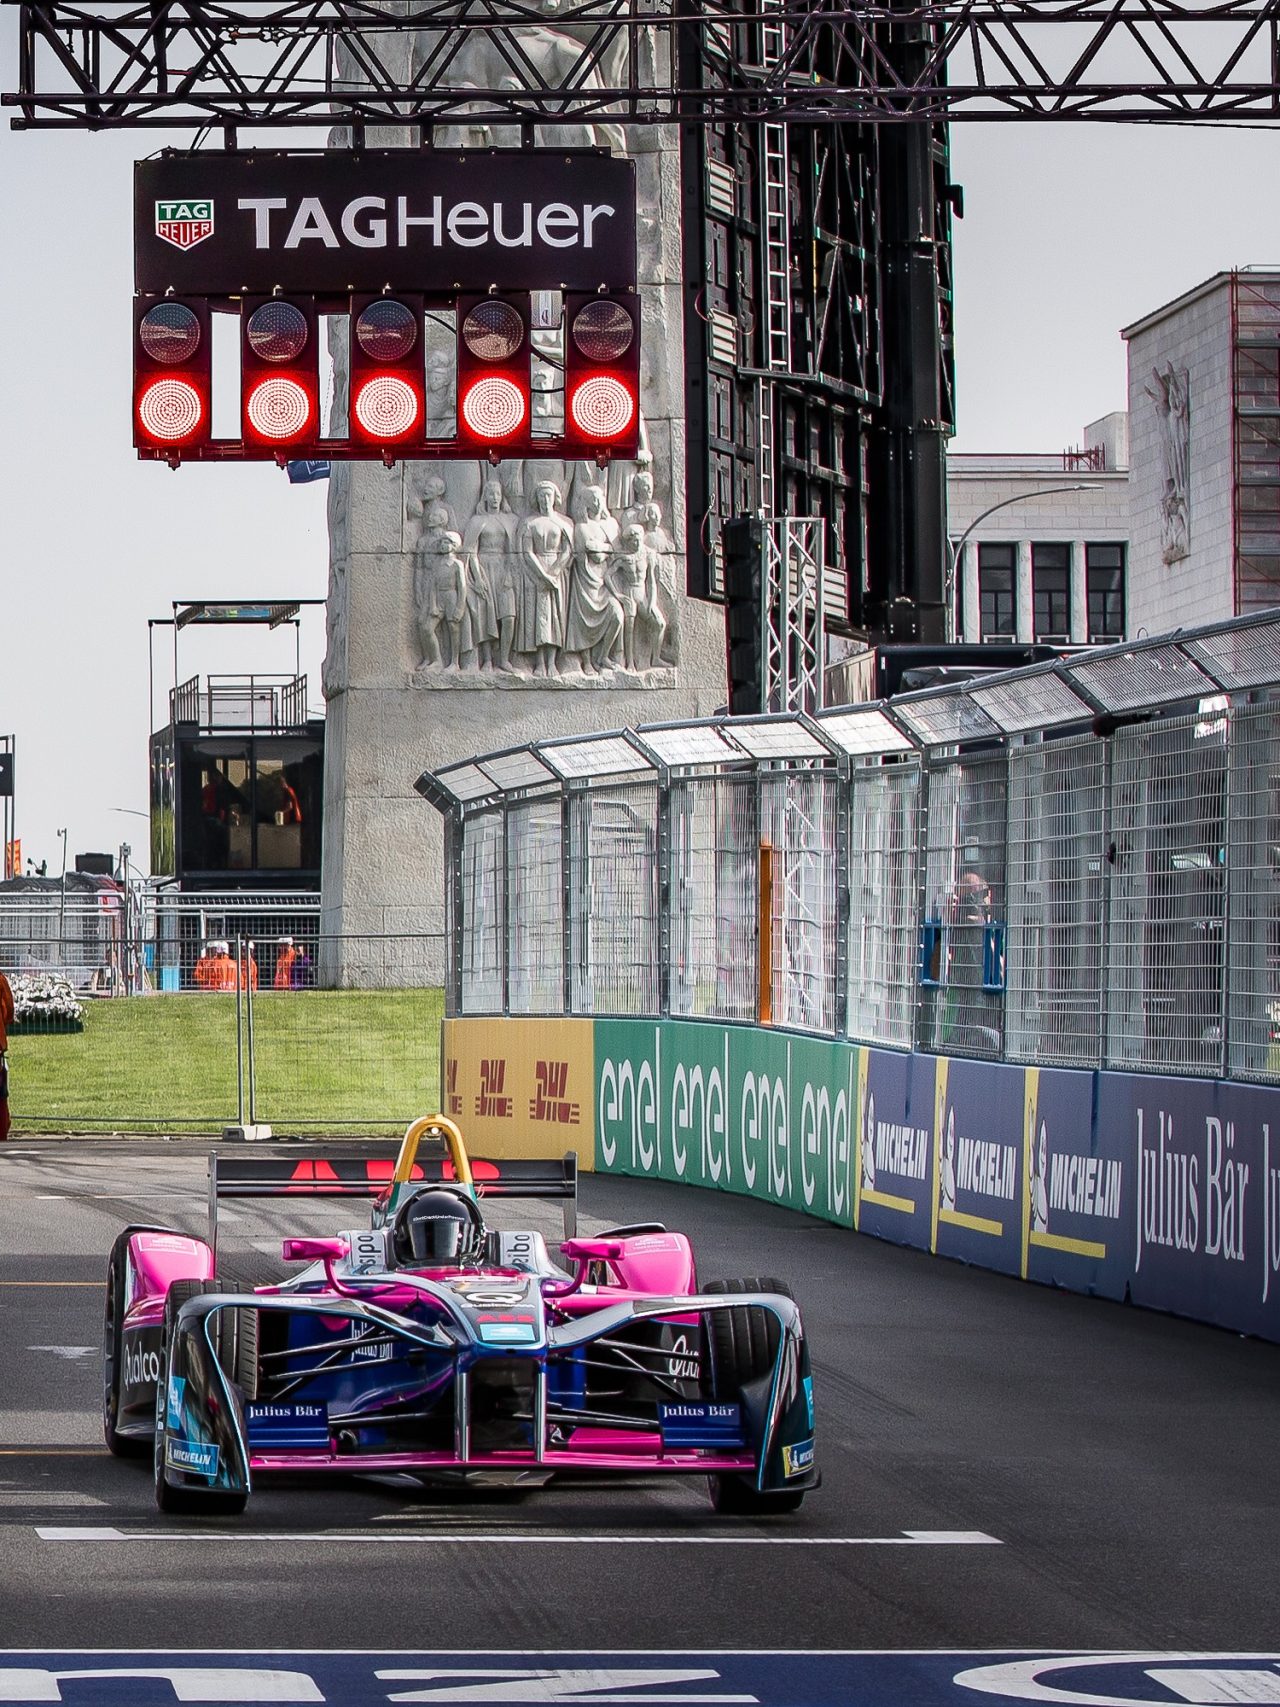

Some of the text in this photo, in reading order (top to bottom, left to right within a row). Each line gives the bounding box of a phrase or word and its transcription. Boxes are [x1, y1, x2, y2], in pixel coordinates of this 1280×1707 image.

[160, 203, 209, 219] TAG
[157, 221, 212, 248] HEUER
[599, 1026, 855, 1219] enel enel enel enel
[876, 1120, 929, 1181] MICHELIN
[957, 1136, 1017, 1201] MICHELIN
[1048, 1152, 1122, 1220] MICHELIN
[1134, 1107, 1200, 1273] Julius
[1205, 1115, 1250, 1261] Bär
[249, 1403, 323, 1418] Julius Bär
[663, 1404, 735, 1418] Julius Bär
[173, 1448, 212, 1465] MICHELIN
